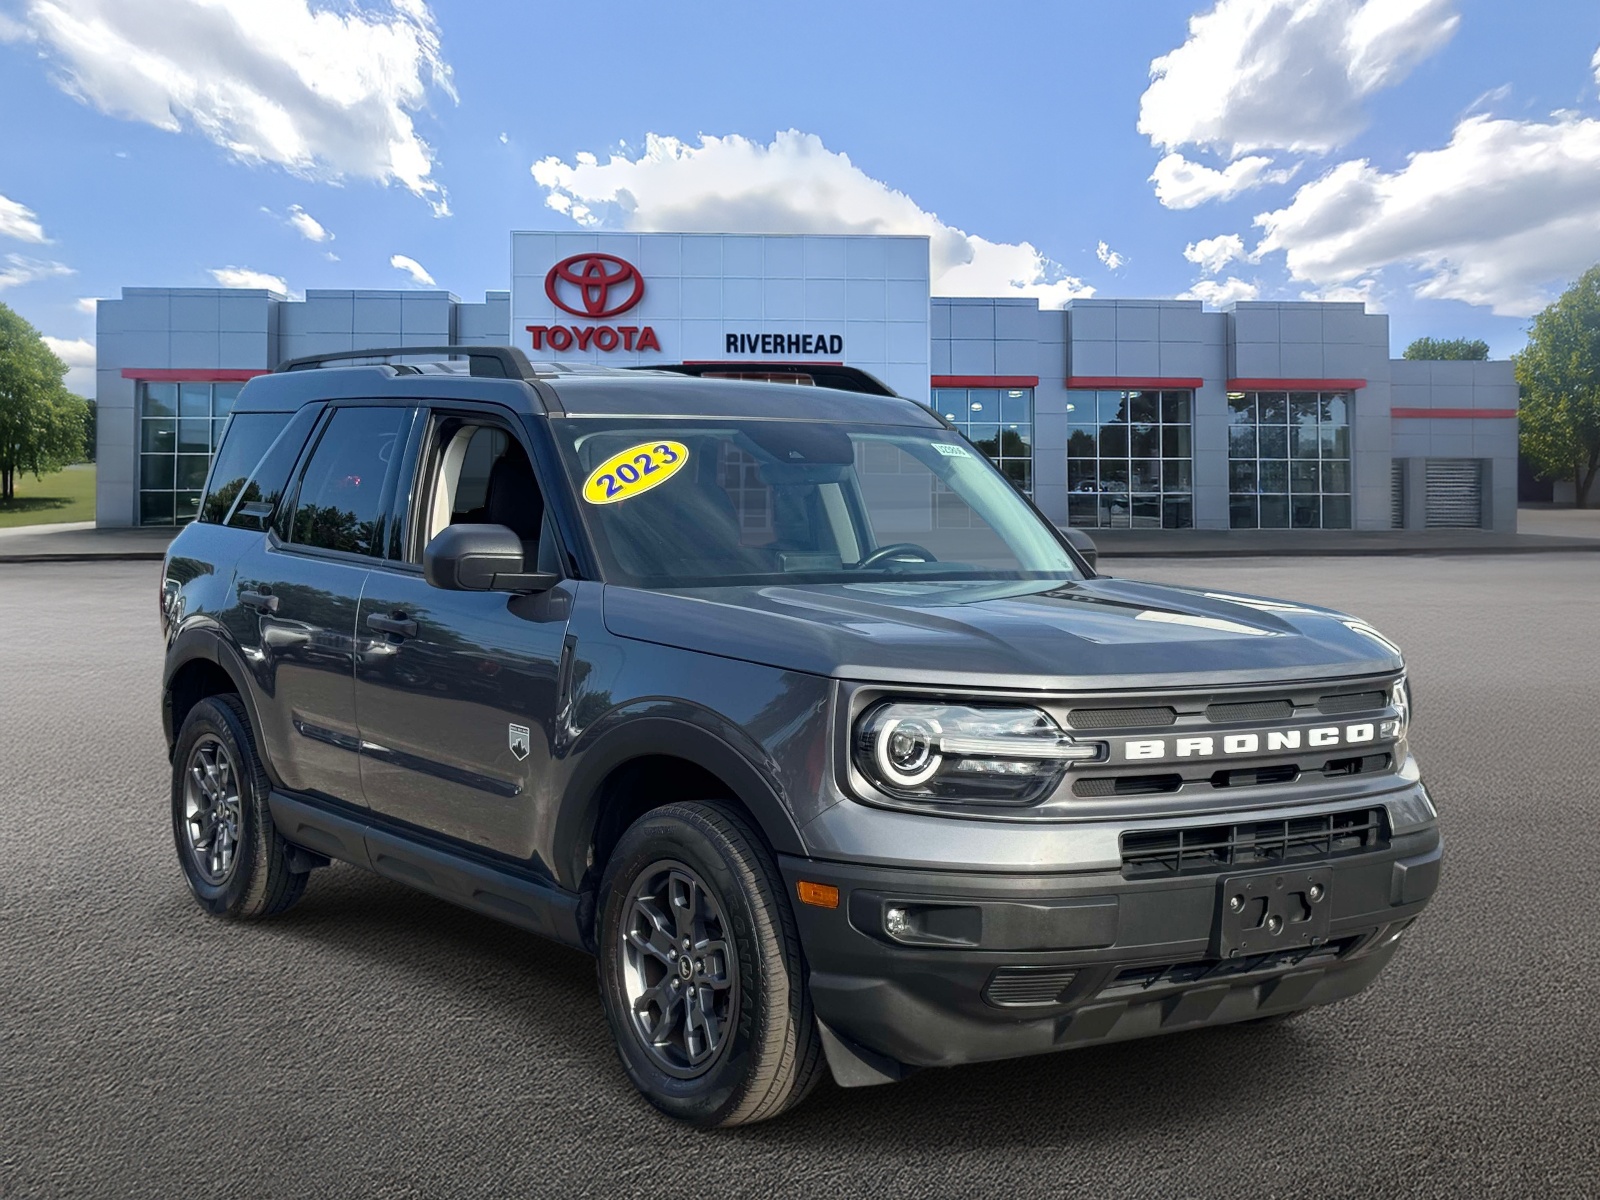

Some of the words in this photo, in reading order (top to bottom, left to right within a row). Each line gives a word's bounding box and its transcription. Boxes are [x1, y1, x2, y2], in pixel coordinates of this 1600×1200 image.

[526, 325, 661, 352] TOYOTA
[725, 333, 843, 355] RIVERHEAD
[597, 444, 678, 498] 2023
[1125, 723, 1374, 760] BRONCO
